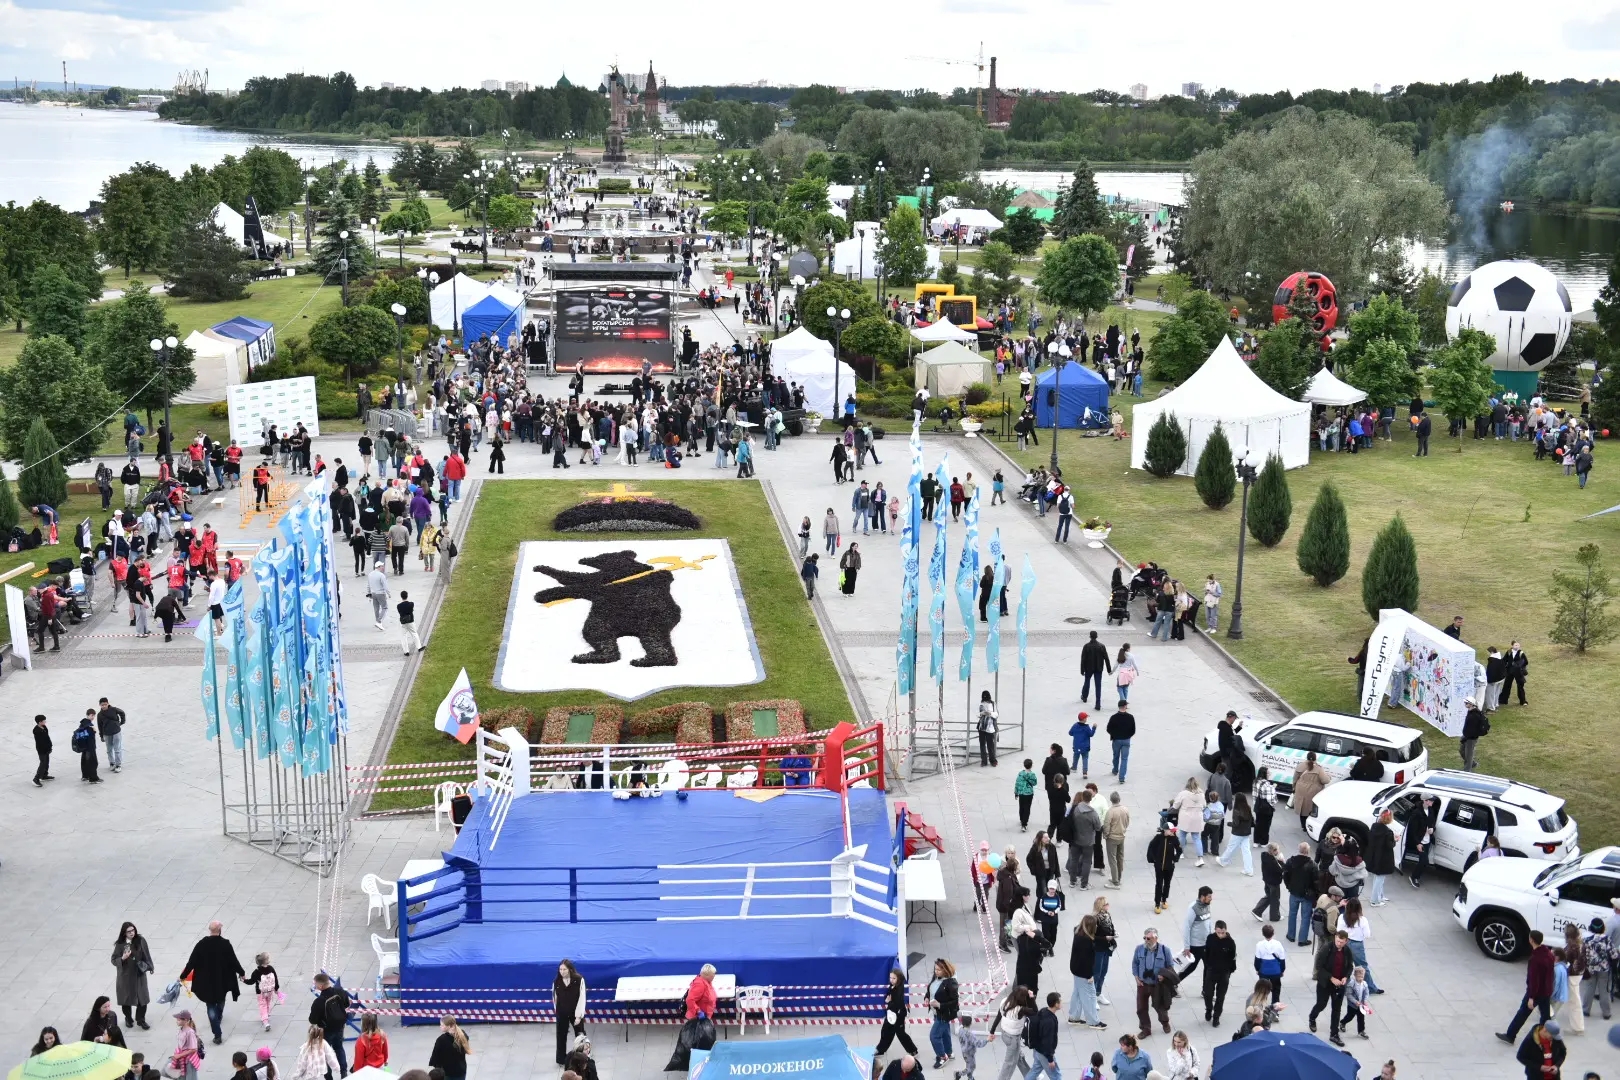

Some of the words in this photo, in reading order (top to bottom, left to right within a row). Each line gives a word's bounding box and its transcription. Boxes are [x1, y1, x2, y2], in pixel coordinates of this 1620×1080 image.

[1262, 754, 1291, 765] HAVAL
[1553, 917, 1588, 931] HAA
[729, 1058, 824, 1076] МОРОЖЕНОЕ
